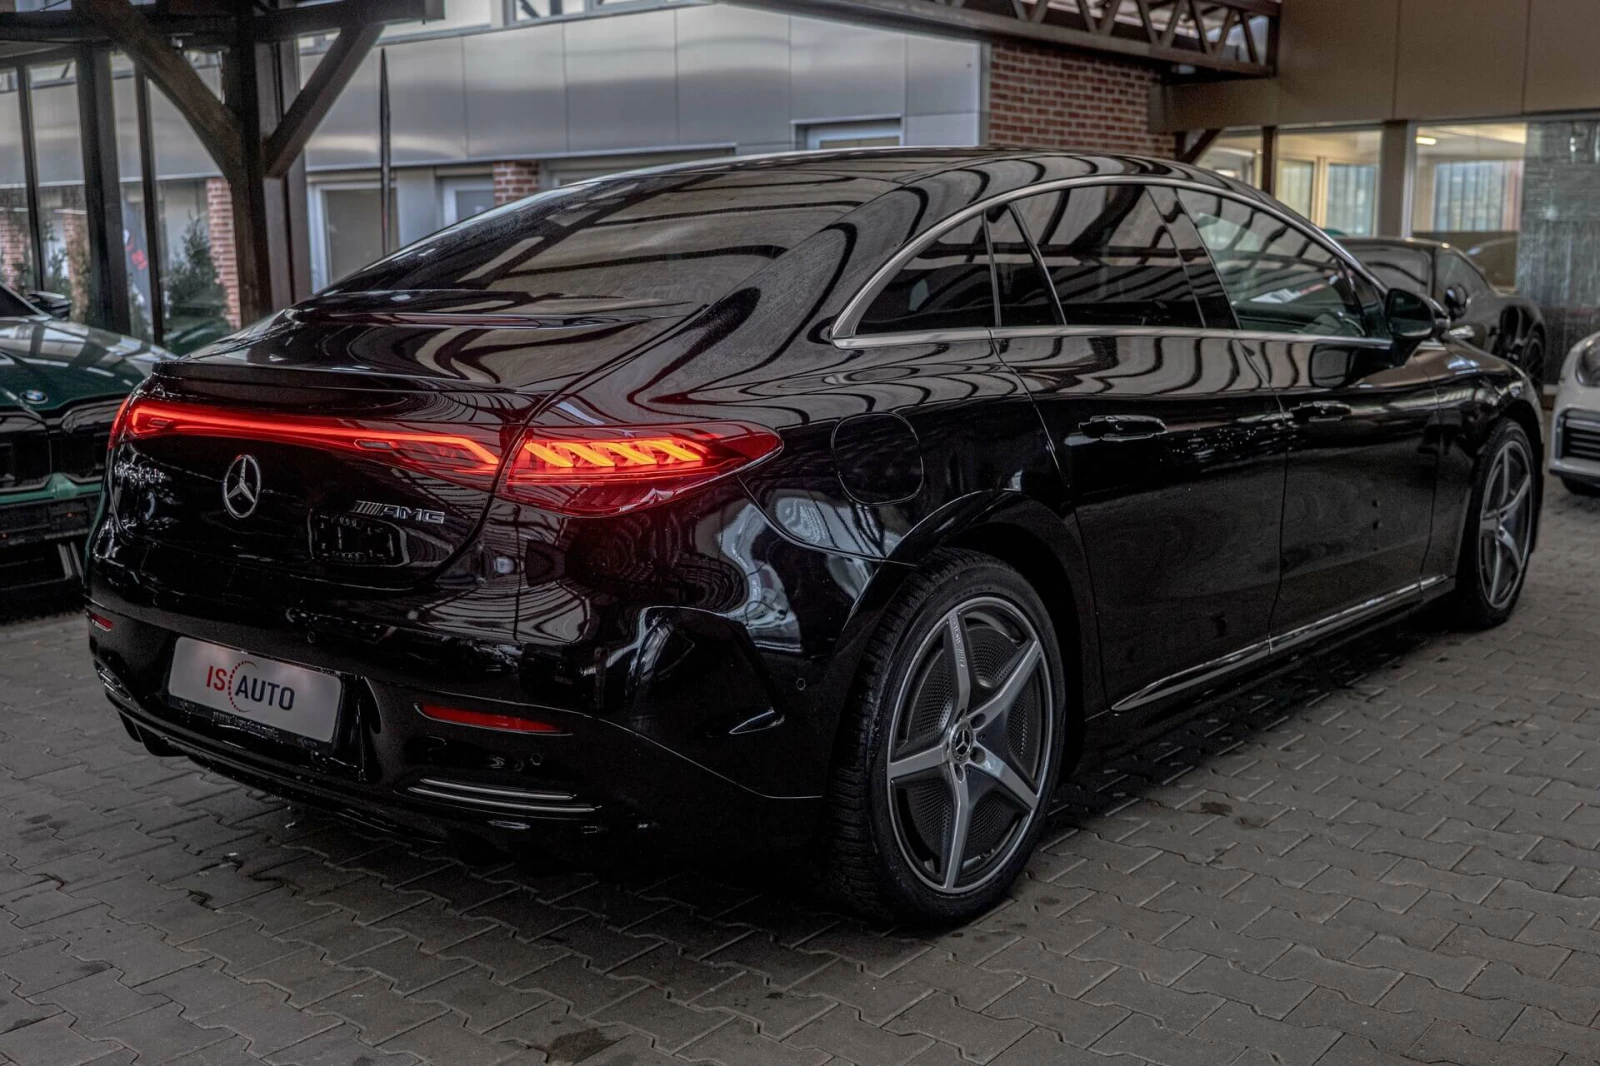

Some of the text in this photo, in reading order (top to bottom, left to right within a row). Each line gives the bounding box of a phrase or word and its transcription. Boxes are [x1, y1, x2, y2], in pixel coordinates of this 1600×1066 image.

[378, 503, 446, 525] AMG
[205, 665, 296, 712] IS AUTO
